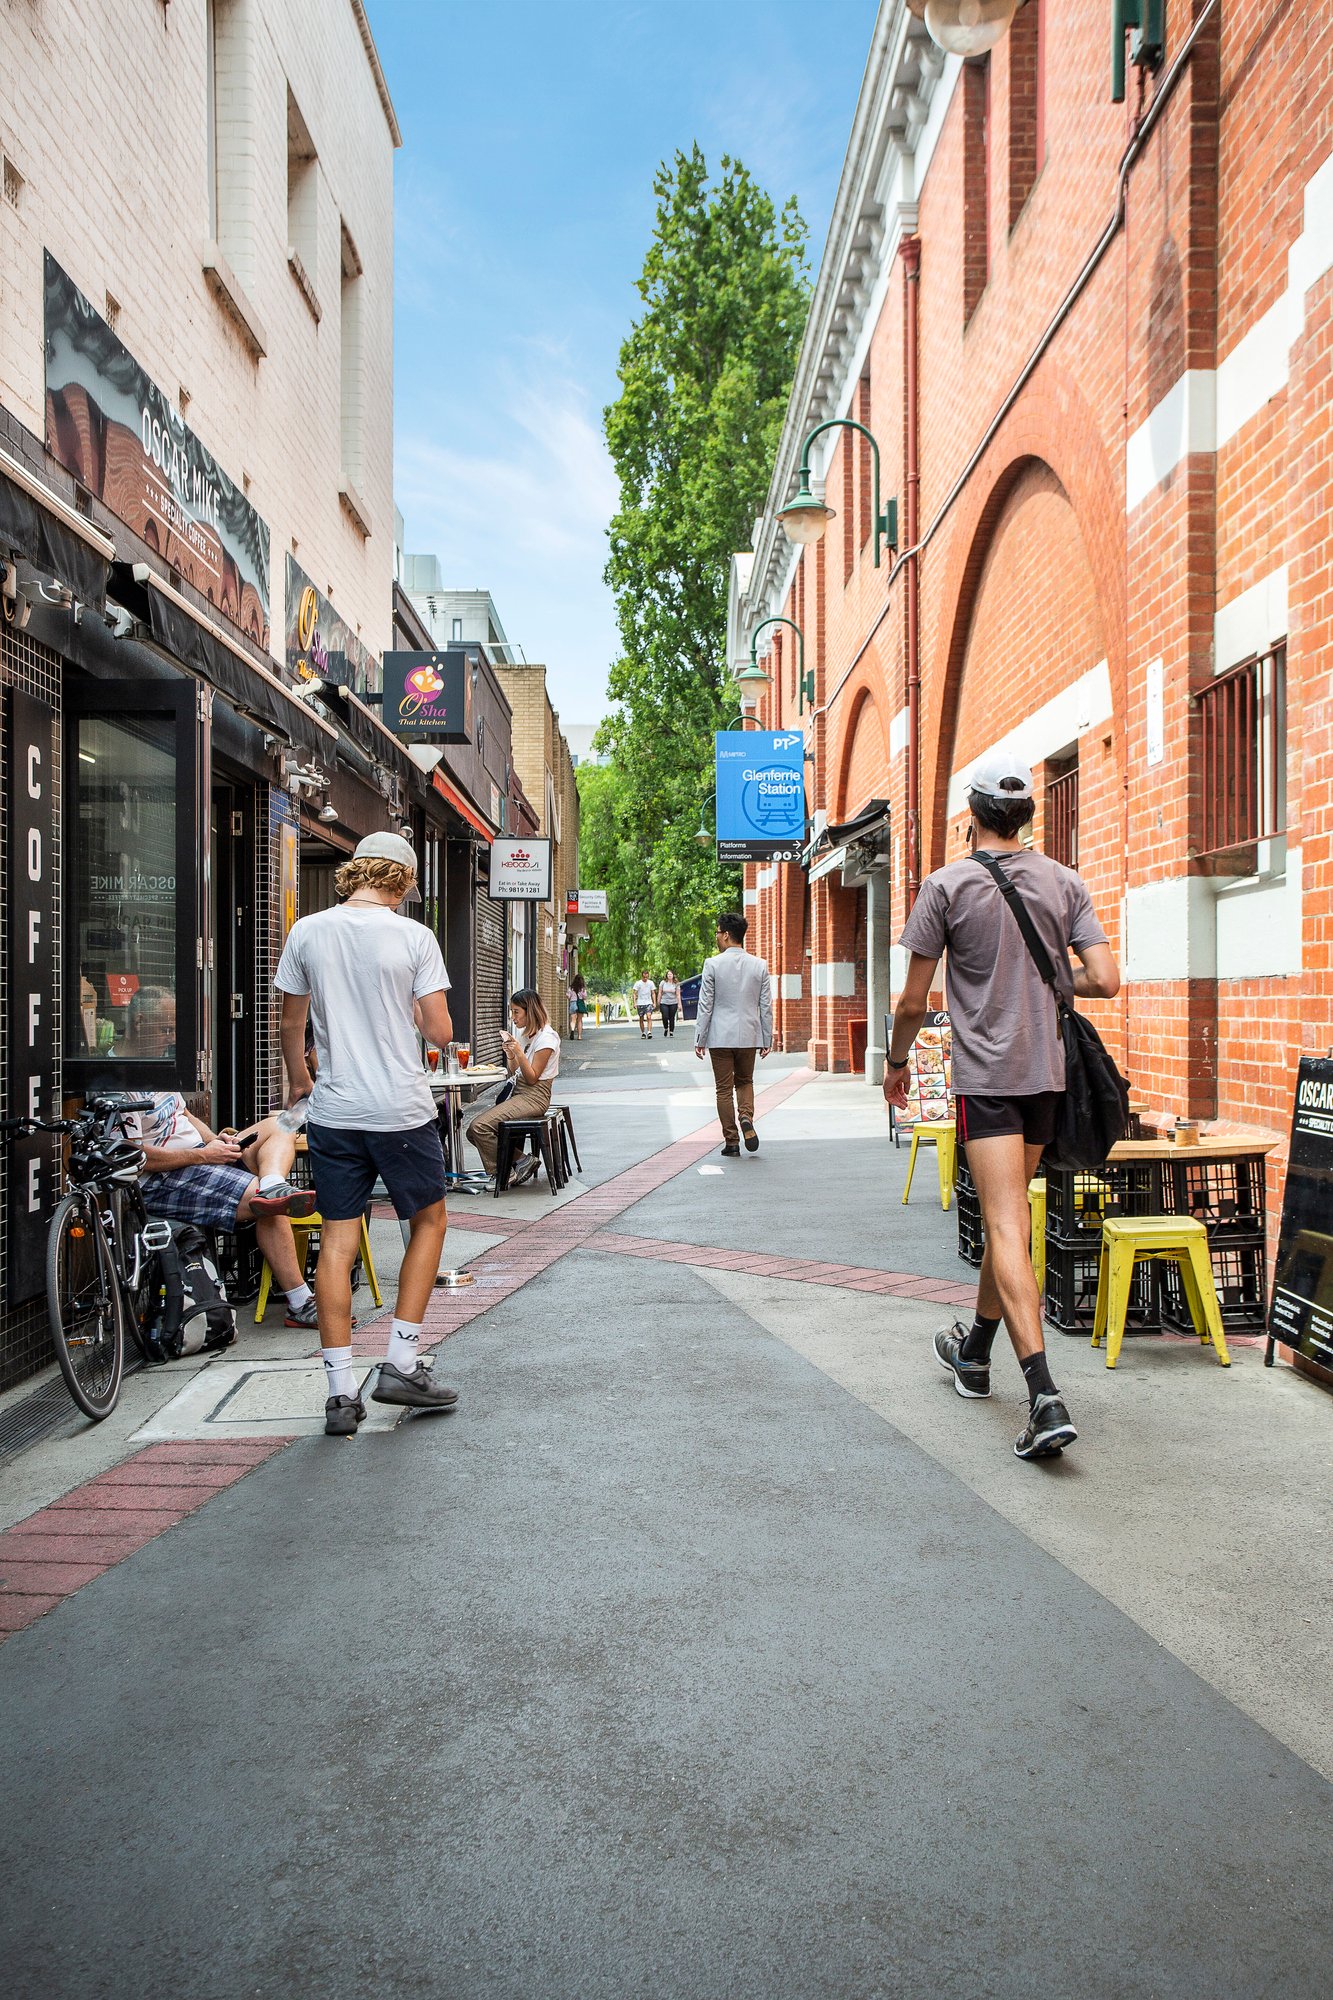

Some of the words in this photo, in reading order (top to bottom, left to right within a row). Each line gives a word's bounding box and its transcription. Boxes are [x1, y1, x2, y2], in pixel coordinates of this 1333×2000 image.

[142, 406, 189, 501] OSCAR
[193, 464, 221, 535] MIKE
[160, 493, 188, 537] SPECIALTY
[188, 525, 206, 555] COFFEE
[398, 692, 447, 717] O'Sha
[398, 718, 417, 726] Thai
[419, 718, 447, 726] kitchen
[742, 769, 801, 782] Glenferrie
[758, 782, 801, 795] Station
[28, 744, 42, 1213] COFFEE
[1299, 1080, 1333, 1110] OSCAR
